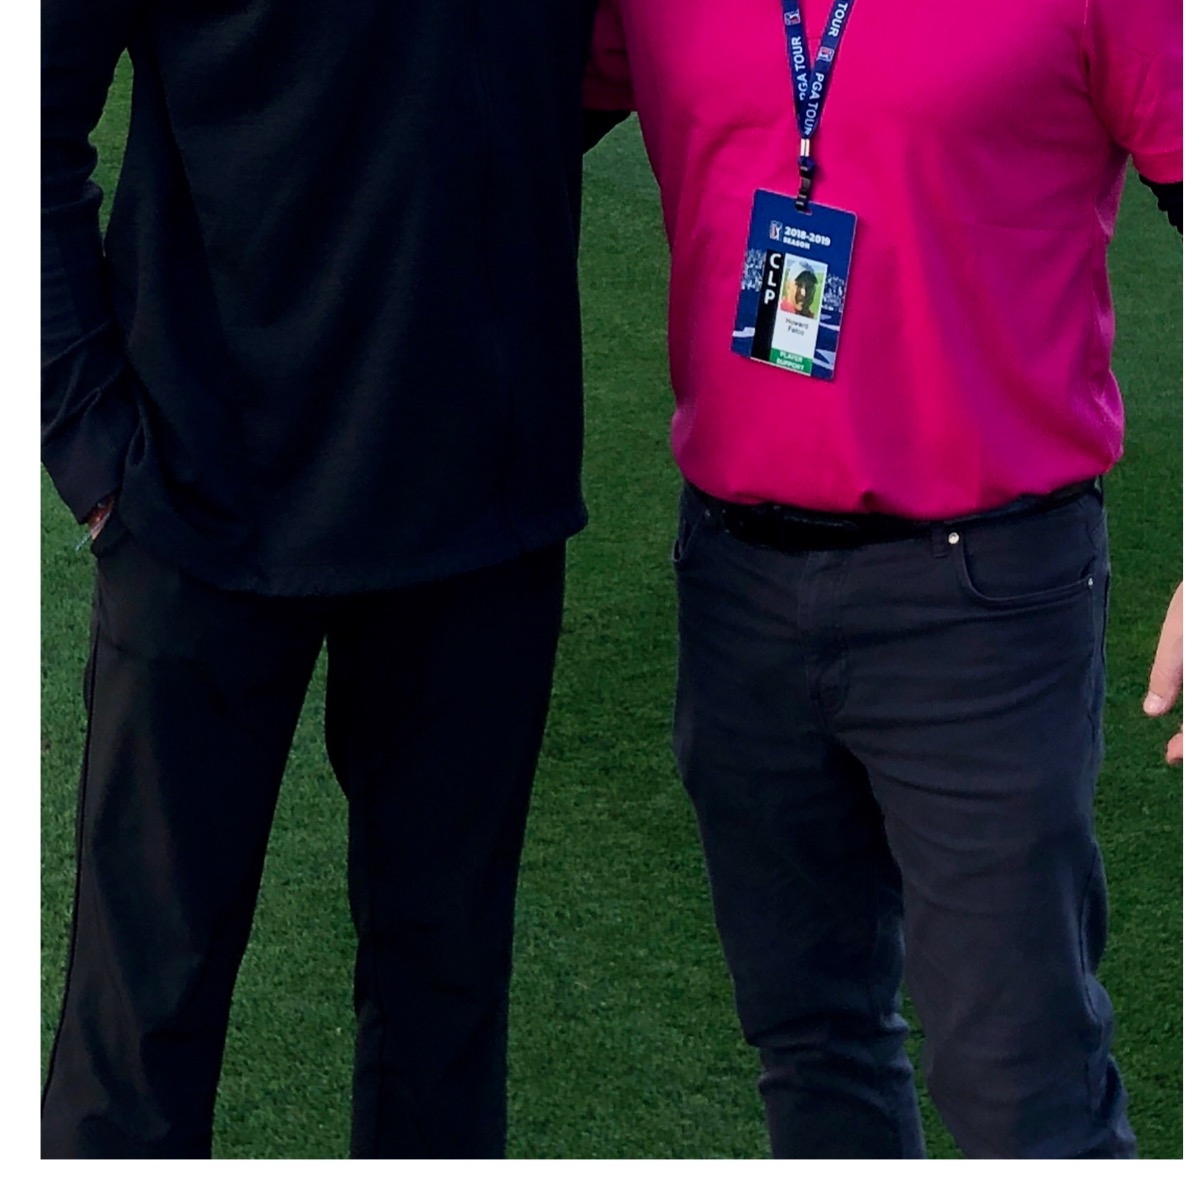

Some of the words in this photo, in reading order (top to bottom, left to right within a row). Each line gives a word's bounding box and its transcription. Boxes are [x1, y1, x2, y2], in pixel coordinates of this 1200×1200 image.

[828, 2, 848, 37] TOUR
[791, 36, 805, 71] TOUR
[809, 72, 825, 100] PGA
[782, 236, 811, 250] SEASON
[783, 225, 831, 247] 2018-2019
